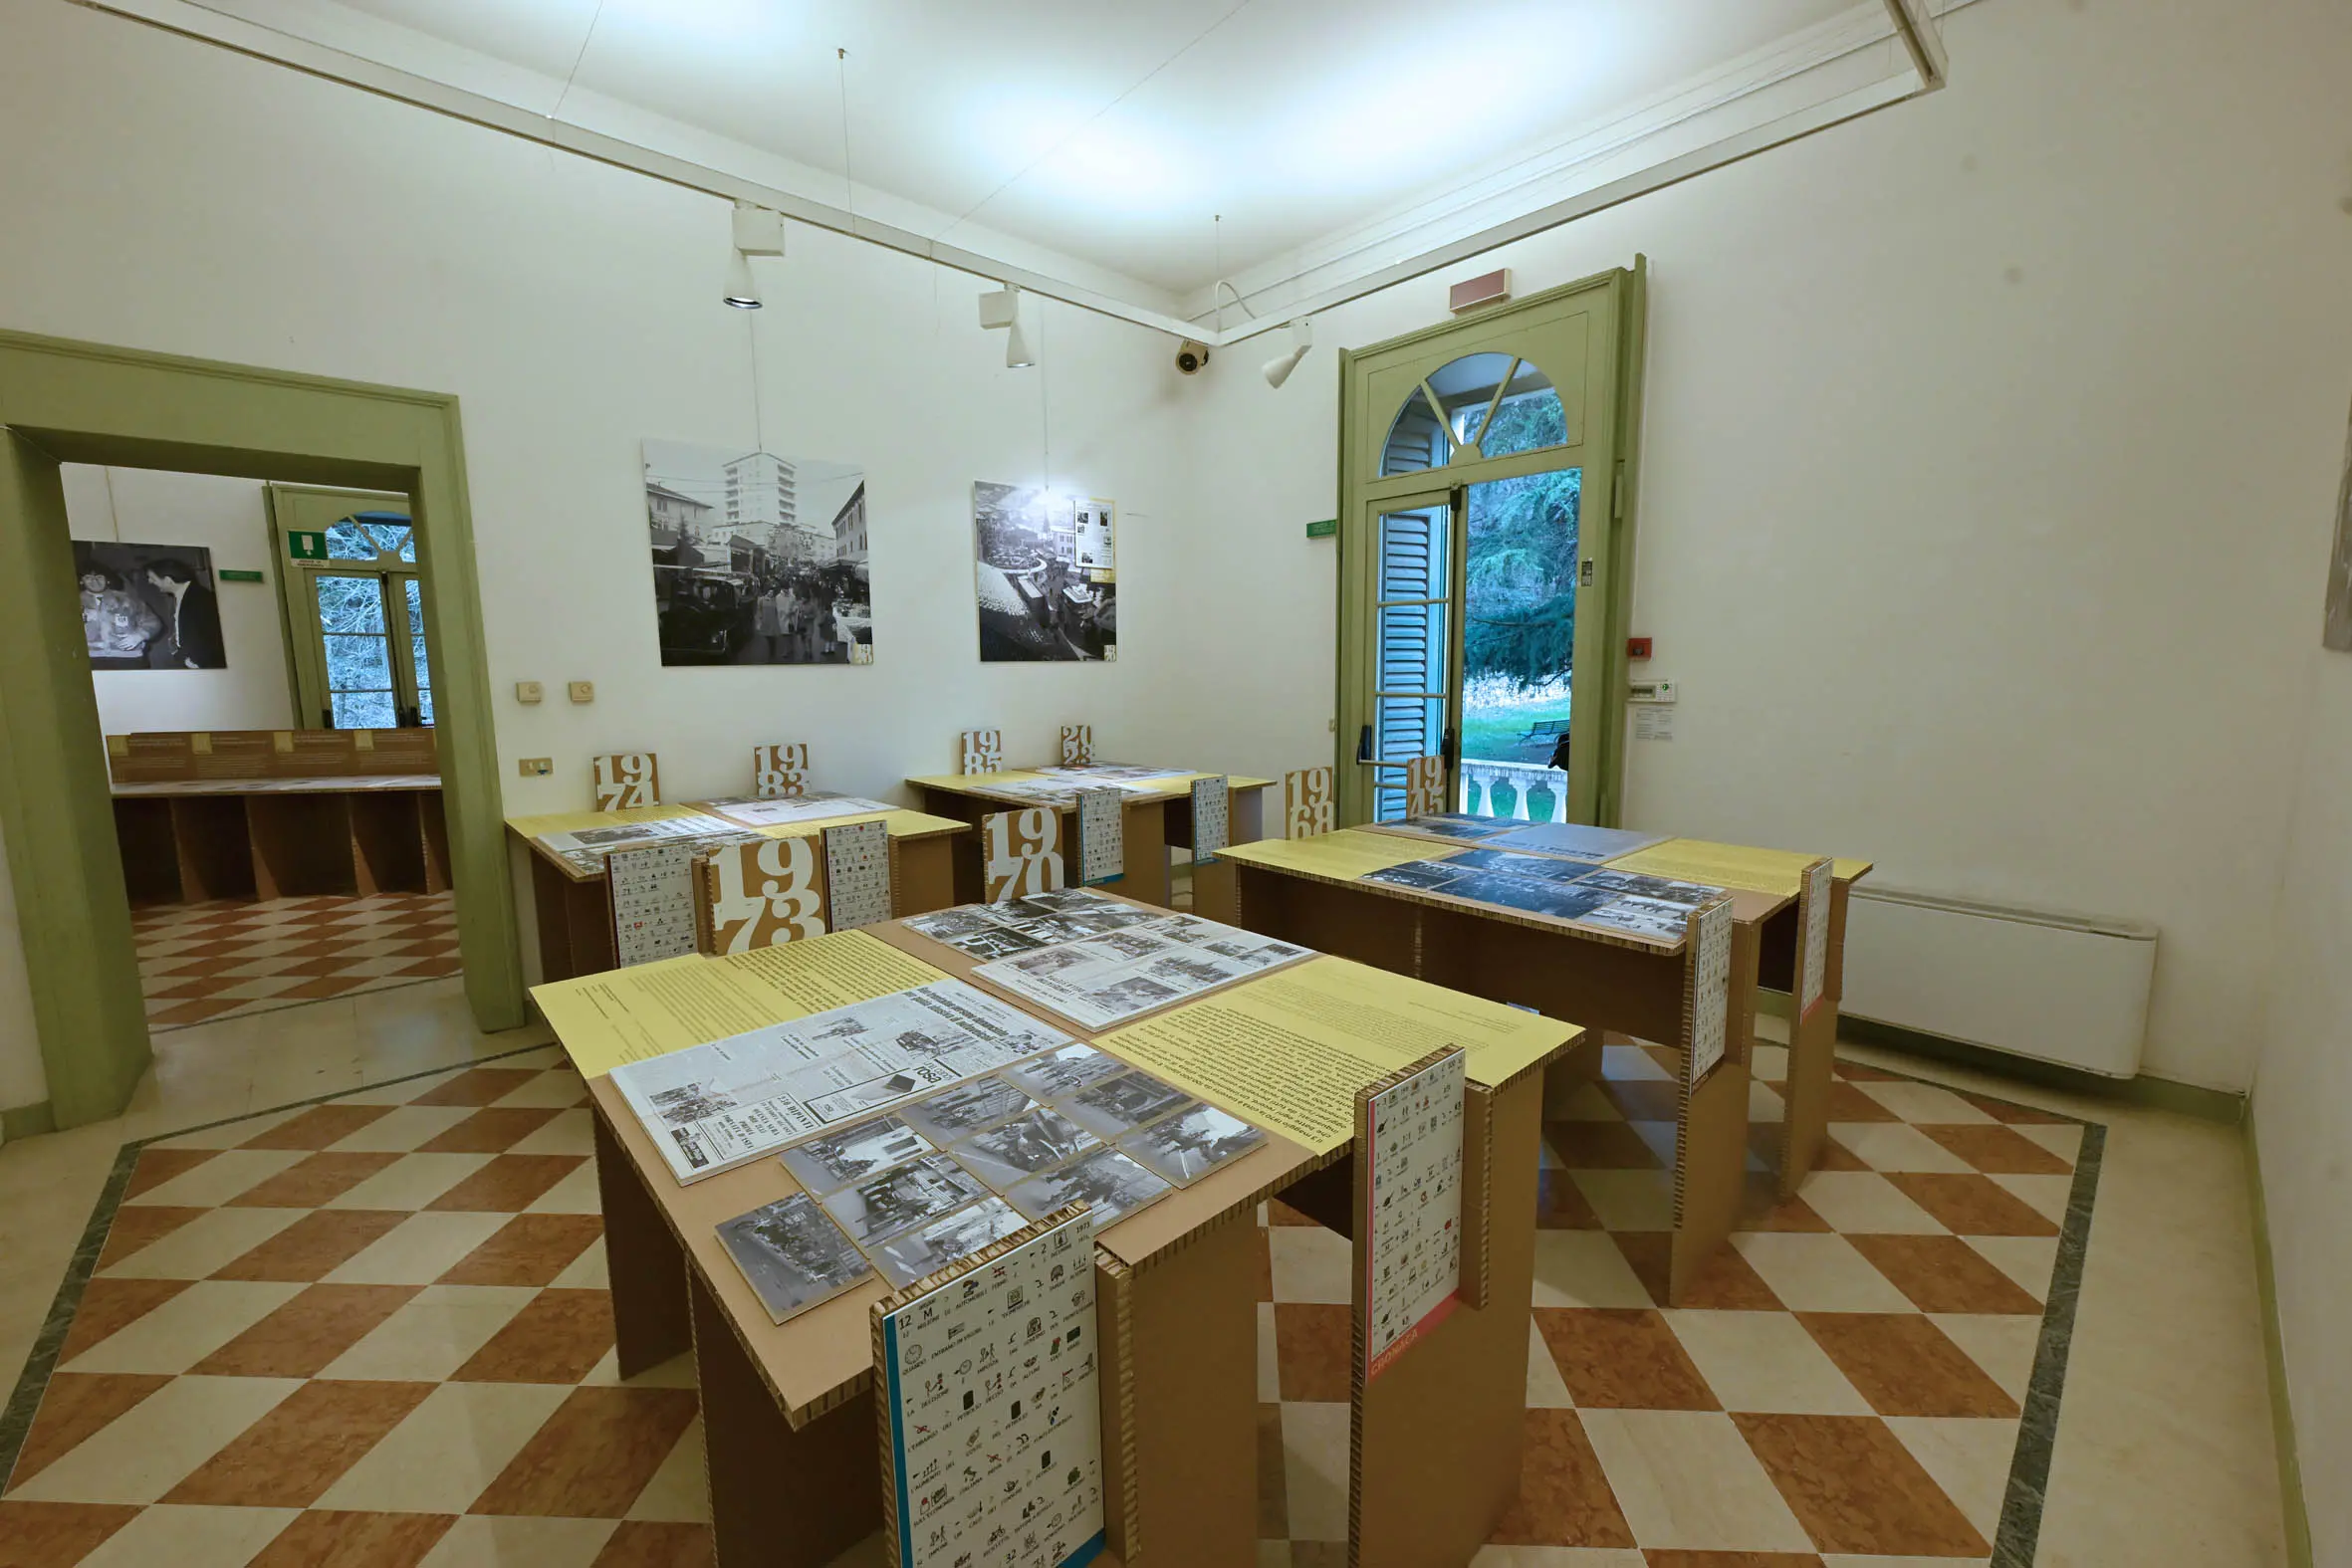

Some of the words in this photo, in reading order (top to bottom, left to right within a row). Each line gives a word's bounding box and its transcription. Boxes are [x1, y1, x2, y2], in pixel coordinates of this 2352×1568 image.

[964, 731, 999, 755] 19
[594, 754, 653, 785] 19
[756, 745, 804, 774] 19
[964, 752, 1002, 776] 85
[758, 769, 810, 796] 83
[1290, 769, 1329, 807] 19
[1409, 757, 1443, 795] 19
[597, 781, 659, 811] 74
[1409, 786, 1443, 820] 45
[1290, 800, 1333, 840] 68
[987, 808, 1058, 861] 19
[709, 838, 815, 902] 19
[988, 854, 1064, 902] 70
[714, 891, 825, 955] 73
[912, 1065, 943, 1083] rosa
[1284, 1084, 1308, 1097] quintali
[1295, 1097, 1314, 1107] ospiti
[1312, 1097, 1332, 1108] 4.000
[1242, 1103, 1258, 1112] città
[1252, 1099, 1274, 1112] record.
[1271, 1100, 1286, 1109] tutti
[1277, 1111, 1292, 1120] ogni
[1266, 1114, 1282, 1123] 1970
[1282, 1122, 1310, 1138] maggio
[1294, 1120, 1313, 1130] batte
[1328, 1119, 1346, 1129] oggi
[898, 1313, 911, 1331] 12
[922, 1305, 932, 1320] M
[1040, 1242, 1047, 1255] 2
[1075, 1220, 1089, 1234] 1973
[1371, 1328, 1418, 1375] CRONACA
[902, 1357, 926, 1376] QUANDO
[957, 1401, 982, 1422] PETROLIO
[965, 1442, 983, 1457] COSTO
[1005, 1411, 1028, 1430] PETROLIO
[959, 1475, 982, 1495] ITALIANA
[1004, 1547, 1017, 1565] 32
